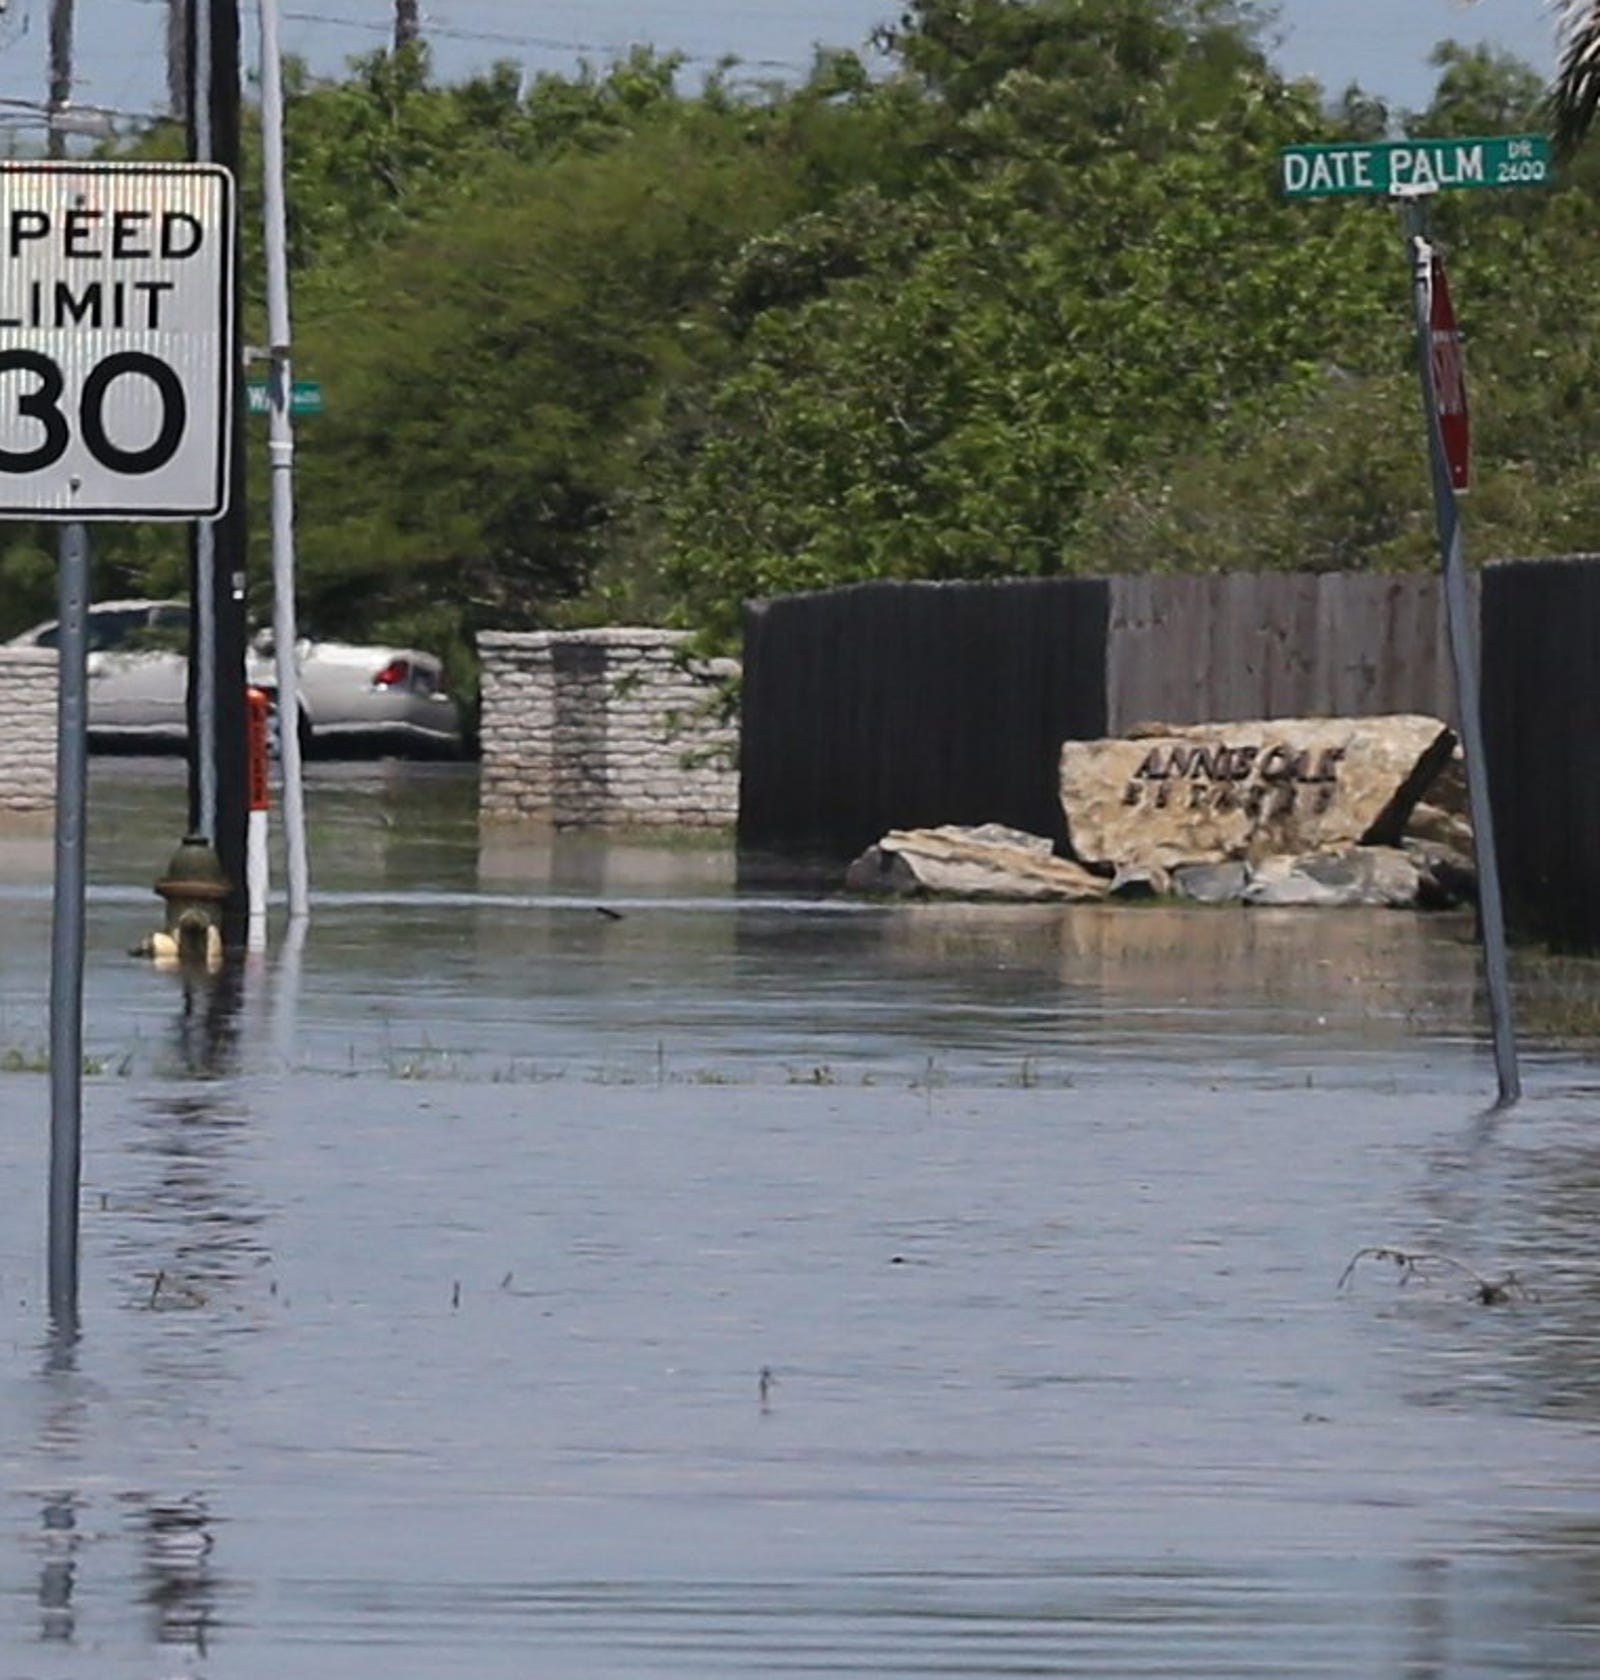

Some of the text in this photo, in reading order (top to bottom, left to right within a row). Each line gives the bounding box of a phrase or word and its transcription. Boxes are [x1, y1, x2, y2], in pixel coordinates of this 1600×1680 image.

[1508, 139, 1533, 159] DR
[1284, 144, 1484, 191] DATE PALM
[1497, 160, 1546, 183] 2600
